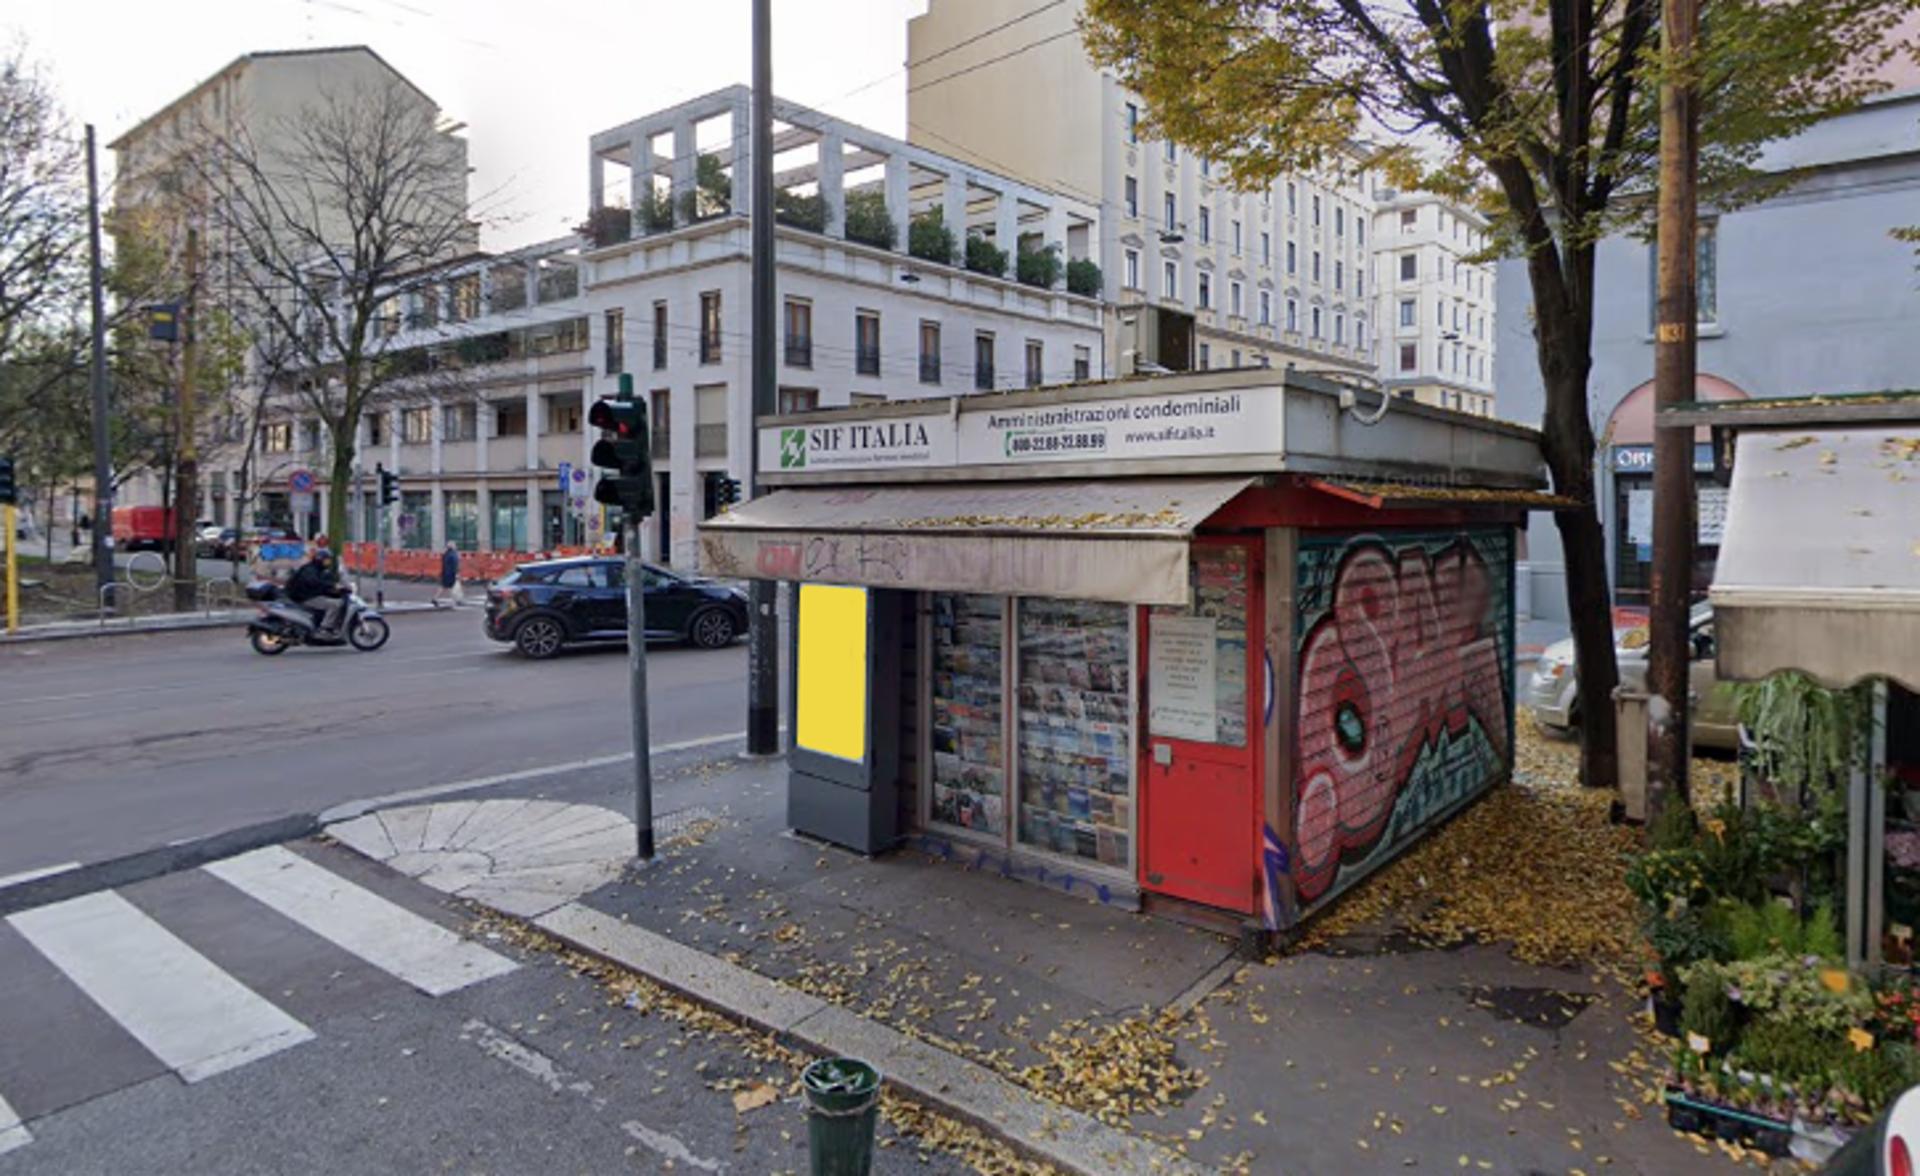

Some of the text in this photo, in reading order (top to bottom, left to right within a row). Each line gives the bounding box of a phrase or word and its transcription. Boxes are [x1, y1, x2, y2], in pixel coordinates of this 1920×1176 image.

[1134, 394, 1241, 420] condominiali
[810, 422, 929, 451] SIF ITALIA
